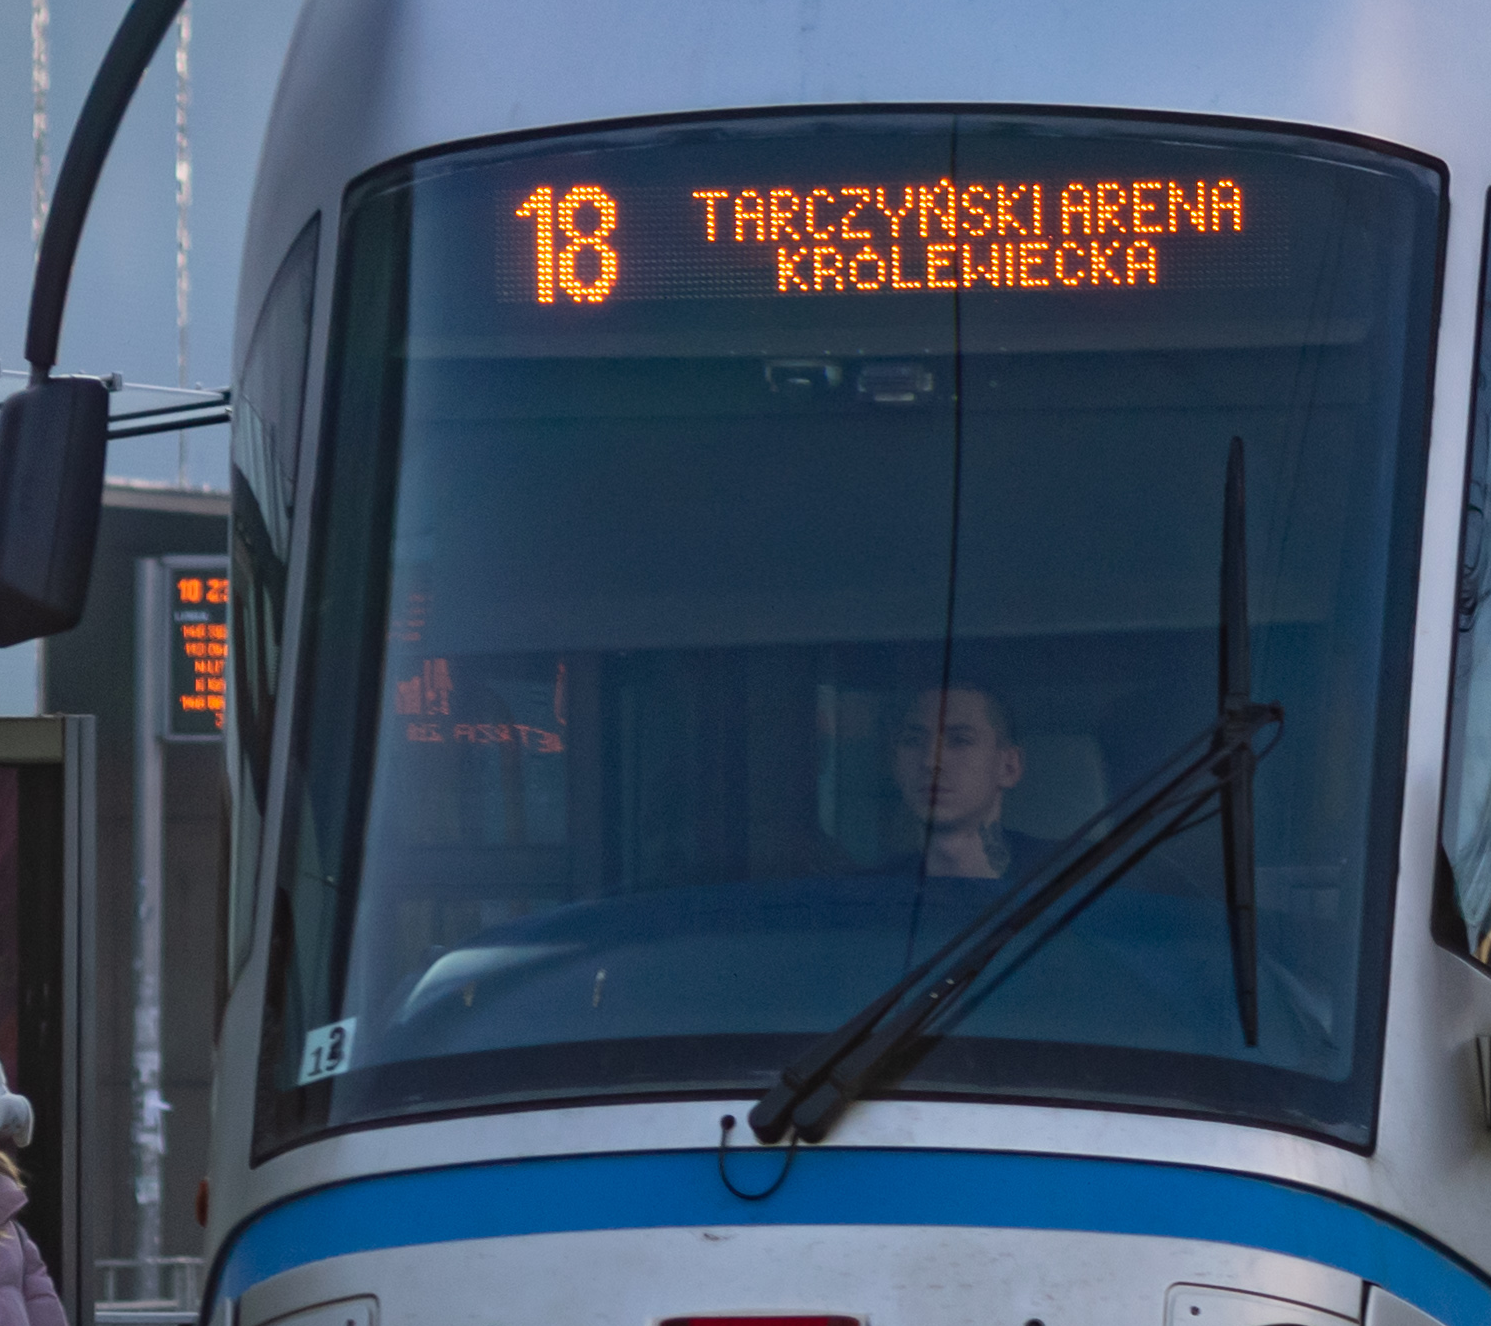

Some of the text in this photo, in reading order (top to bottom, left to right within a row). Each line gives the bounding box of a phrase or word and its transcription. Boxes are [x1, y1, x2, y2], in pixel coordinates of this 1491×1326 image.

[515, 185, 616, 303] 18
[693, 178, 1242, 242] TARCZYŃSKI ARENA
